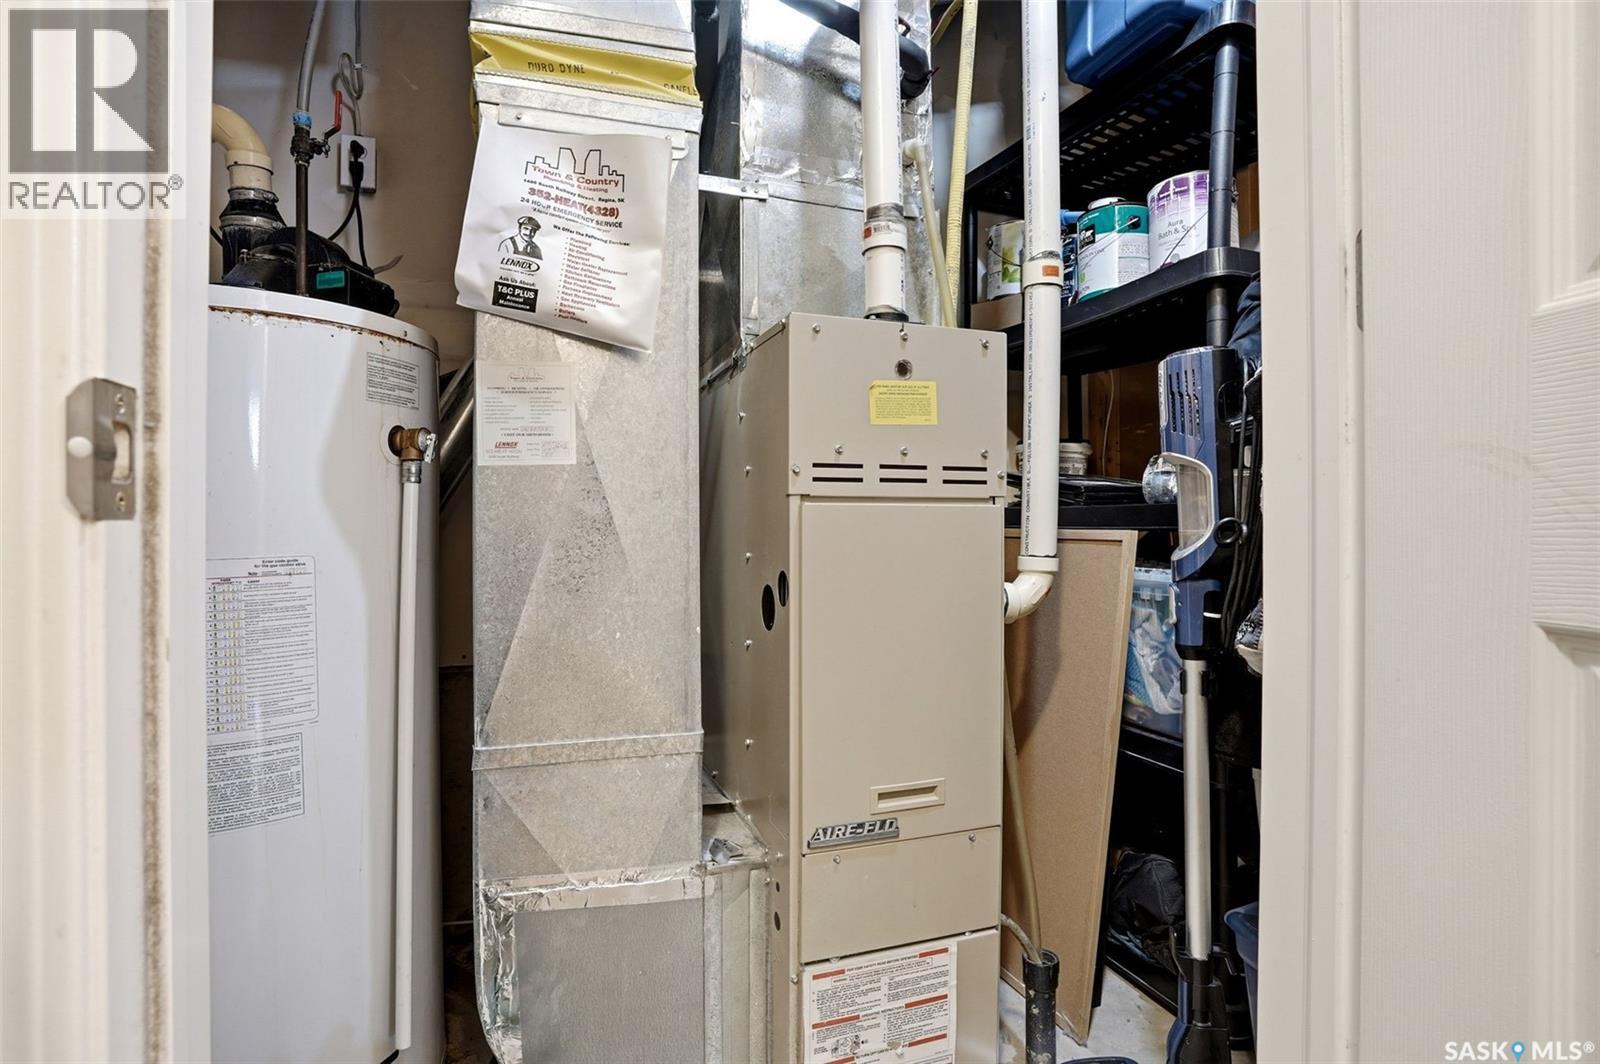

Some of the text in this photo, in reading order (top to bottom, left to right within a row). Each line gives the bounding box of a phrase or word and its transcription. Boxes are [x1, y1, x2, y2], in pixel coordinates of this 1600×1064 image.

[528, 61, 586, 74] DURO DYNE
[532, 165, 561, 178] Town
[576, 176, 619, 187] Country
[528, 187, 619, 219] 352-HEAT(4328)
[531, 199, 552, 211] HOUR
[553, 205, 594, 223] EMERGENCY
[596, 218, 623, 228] SERVICE
[1168, 219, 1183, 227] Aura
[500, 257, 532, 270] LENNOX
[497, 285, 535, 299] T&C PLUS
